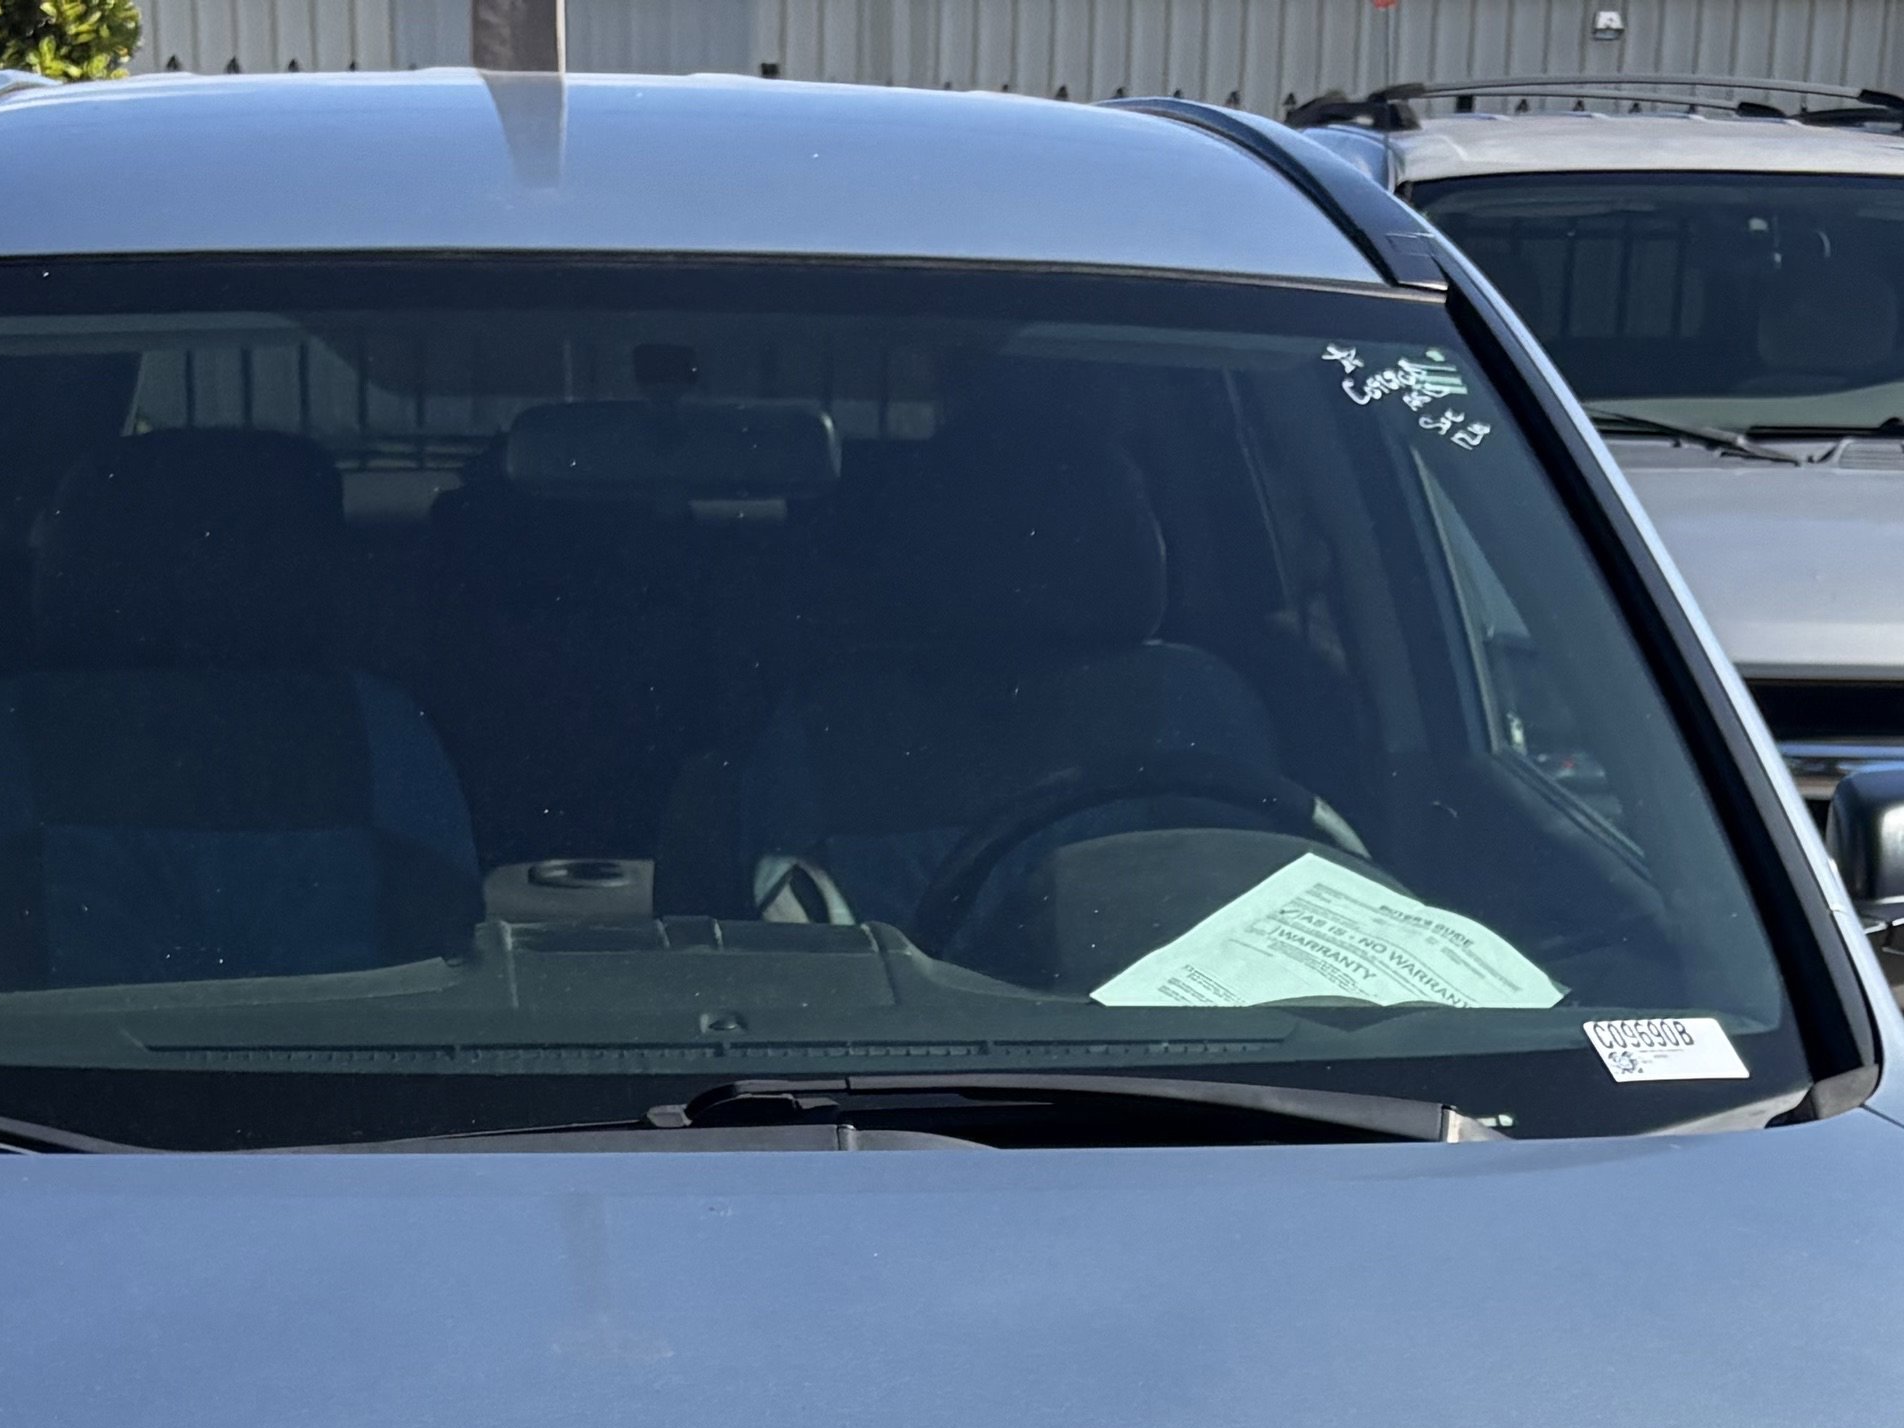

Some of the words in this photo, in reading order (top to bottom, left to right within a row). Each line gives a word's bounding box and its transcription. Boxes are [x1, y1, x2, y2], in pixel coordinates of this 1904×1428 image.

[1300, 915, 1328, 928] AS
[1327, 925, 1348, 937] IS
[1357, 937, 1388, 954] NO
[1278, 929, 1377, 980] WARRANTY
[1593, 1020, 1695, 1049] C09690B
